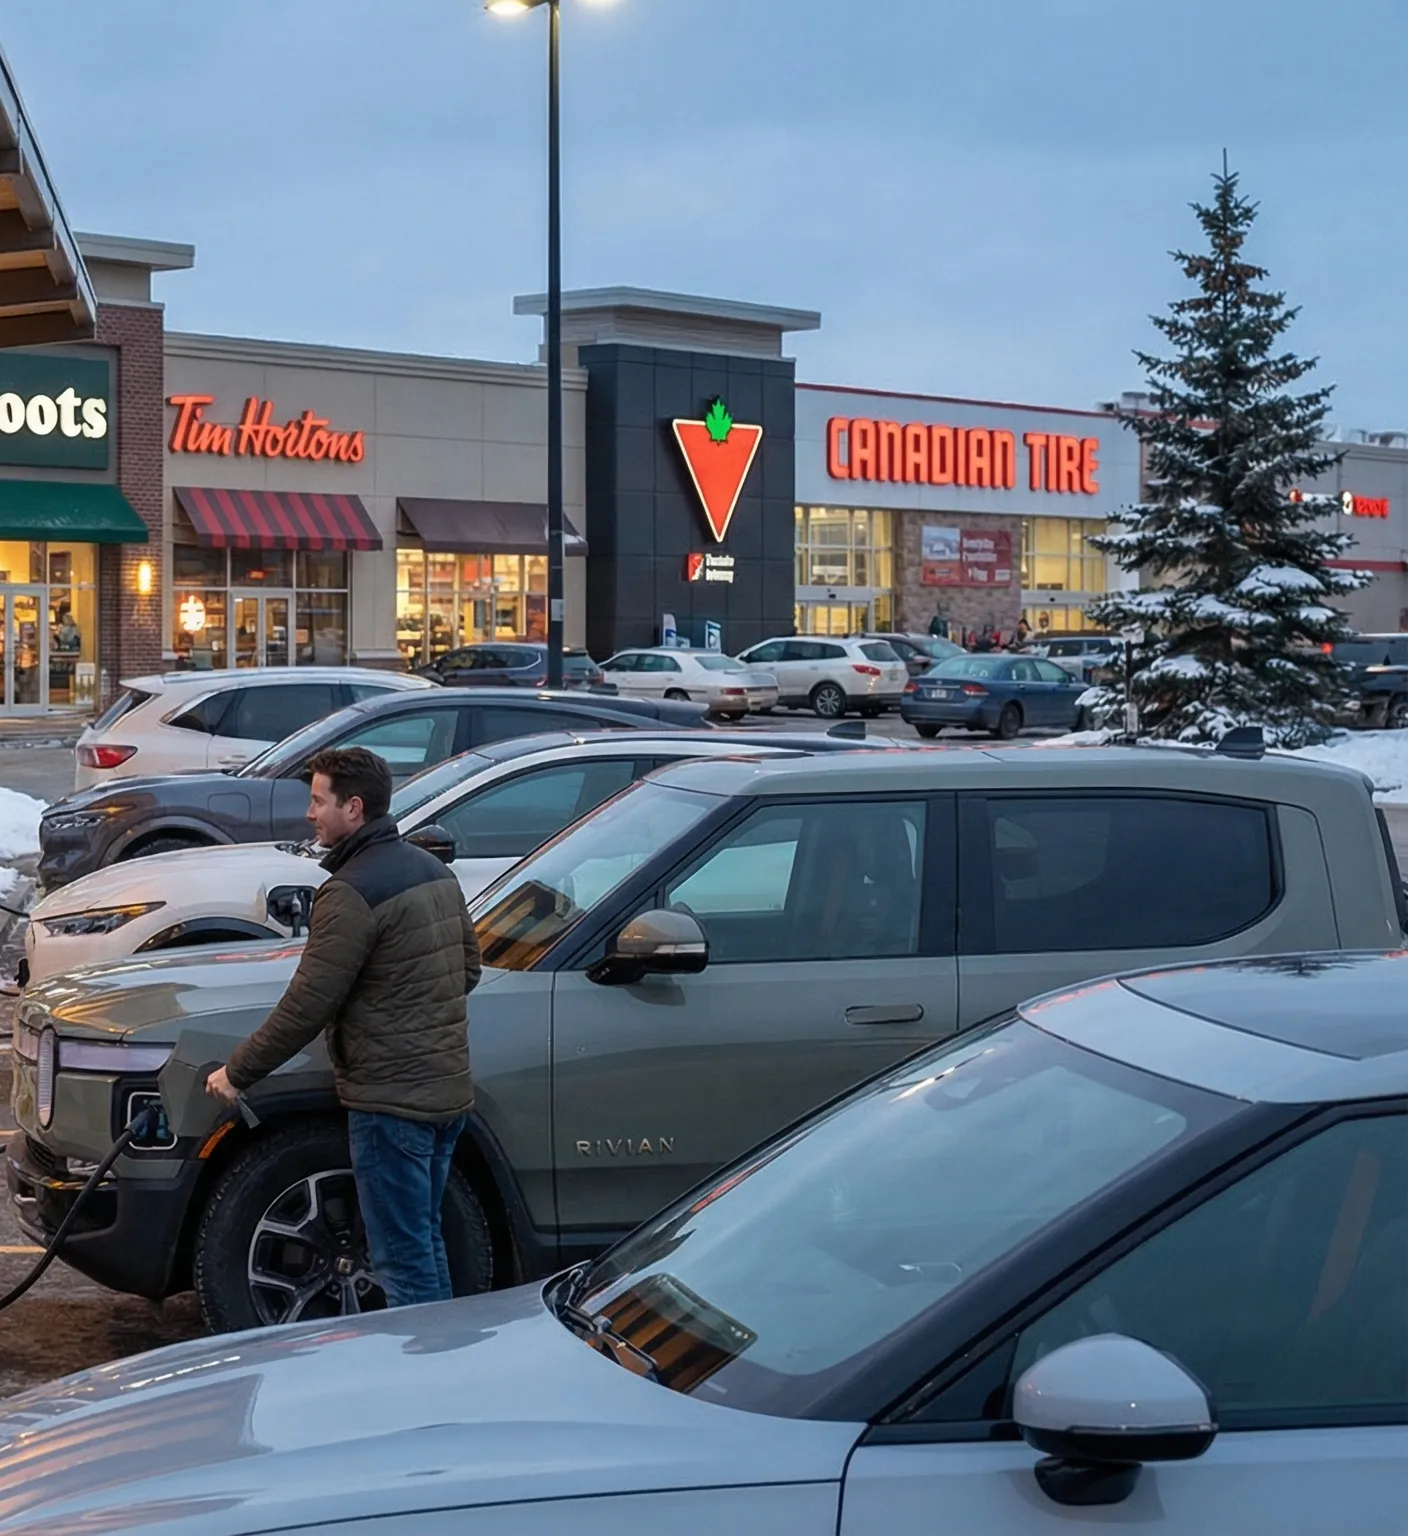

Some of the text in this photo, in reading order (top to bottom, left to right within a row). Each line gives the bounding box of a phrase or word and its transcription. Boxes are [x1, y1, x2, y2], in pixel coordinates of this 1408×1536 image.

[167, 394, 365, 463] Tim Hortons
[827, 416, 1100, 495] CANADIAN TIRE
[575, 1136, 674, 1156] RIVIAN
